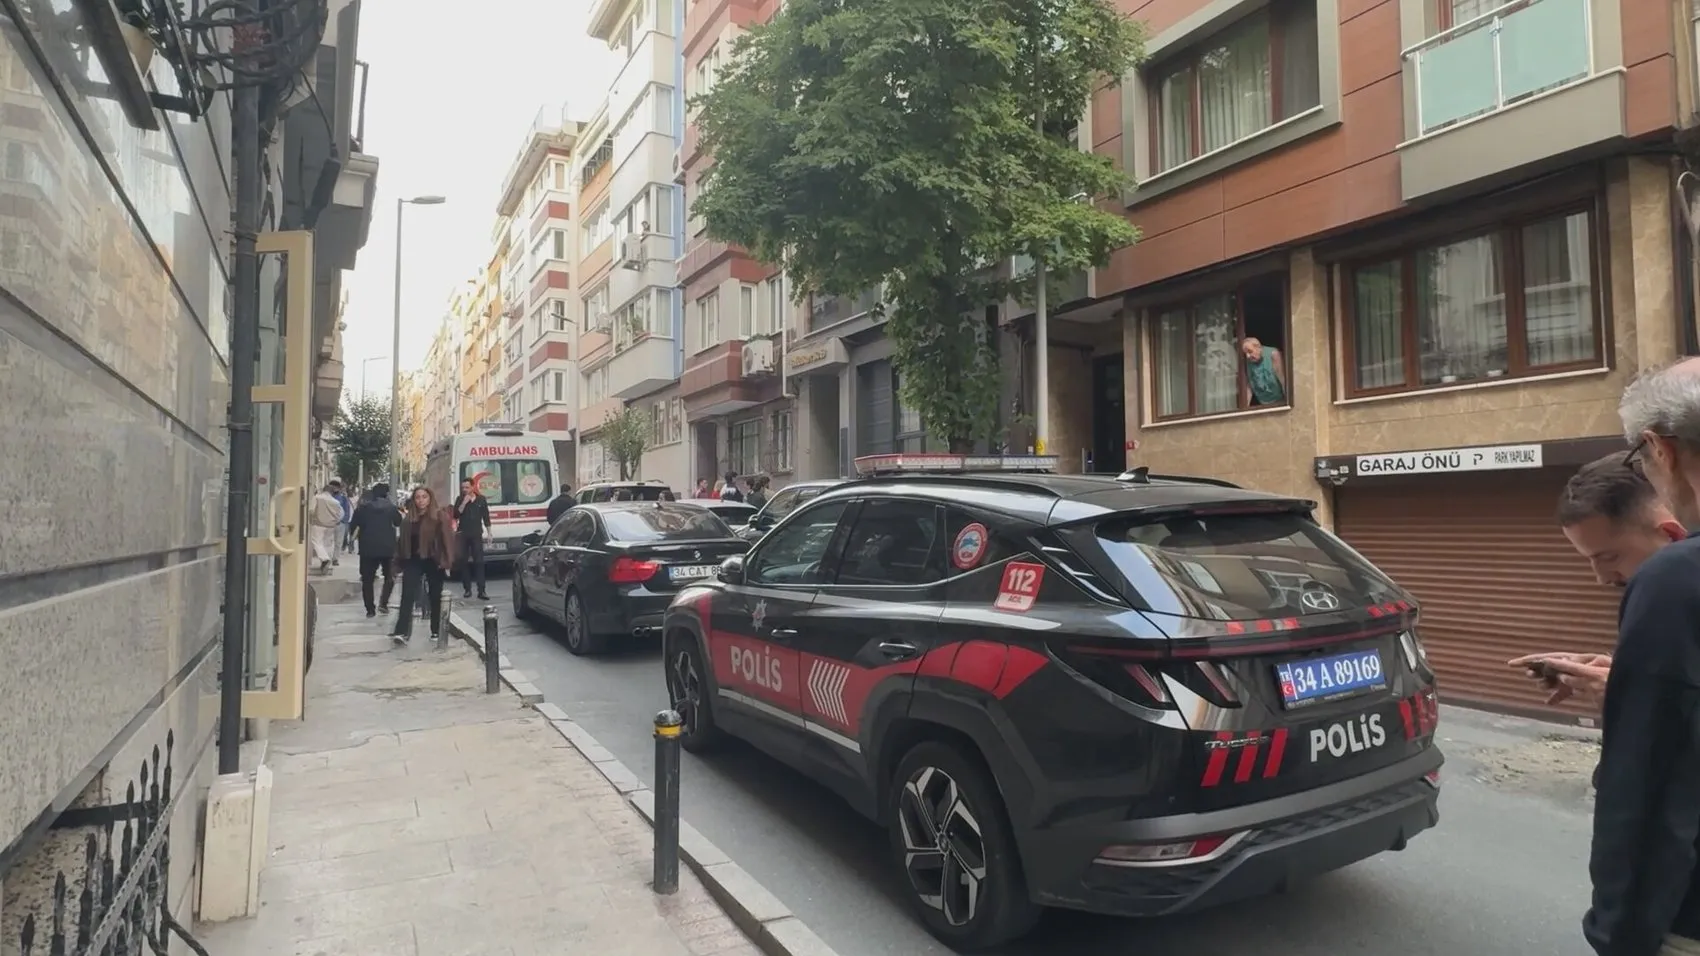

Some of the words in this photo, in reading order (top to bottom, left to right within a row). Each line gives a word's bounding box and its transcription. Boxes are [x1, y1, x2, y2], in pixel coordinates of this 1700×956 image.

[470, 446, 538, 457] AMBULANS
[1359, 456, 1417, 472] GARAJ
[1421, 451, 1461, 469] ÖNÜ
[1494, 450, 1509, 464] PARK
[674, 568, 686, 577] 34
[688, 567, 707, 576] CAT
[1008, 569, 1037, 592] 112
[730, 645, 783, 692] POLİS
[1295, 667, 1317, 693] 34
[1320, 662, 1335, 689] A
[1334, 654, 1381, 685] 89169
[1310, 713, 1387, 762] POLİS
